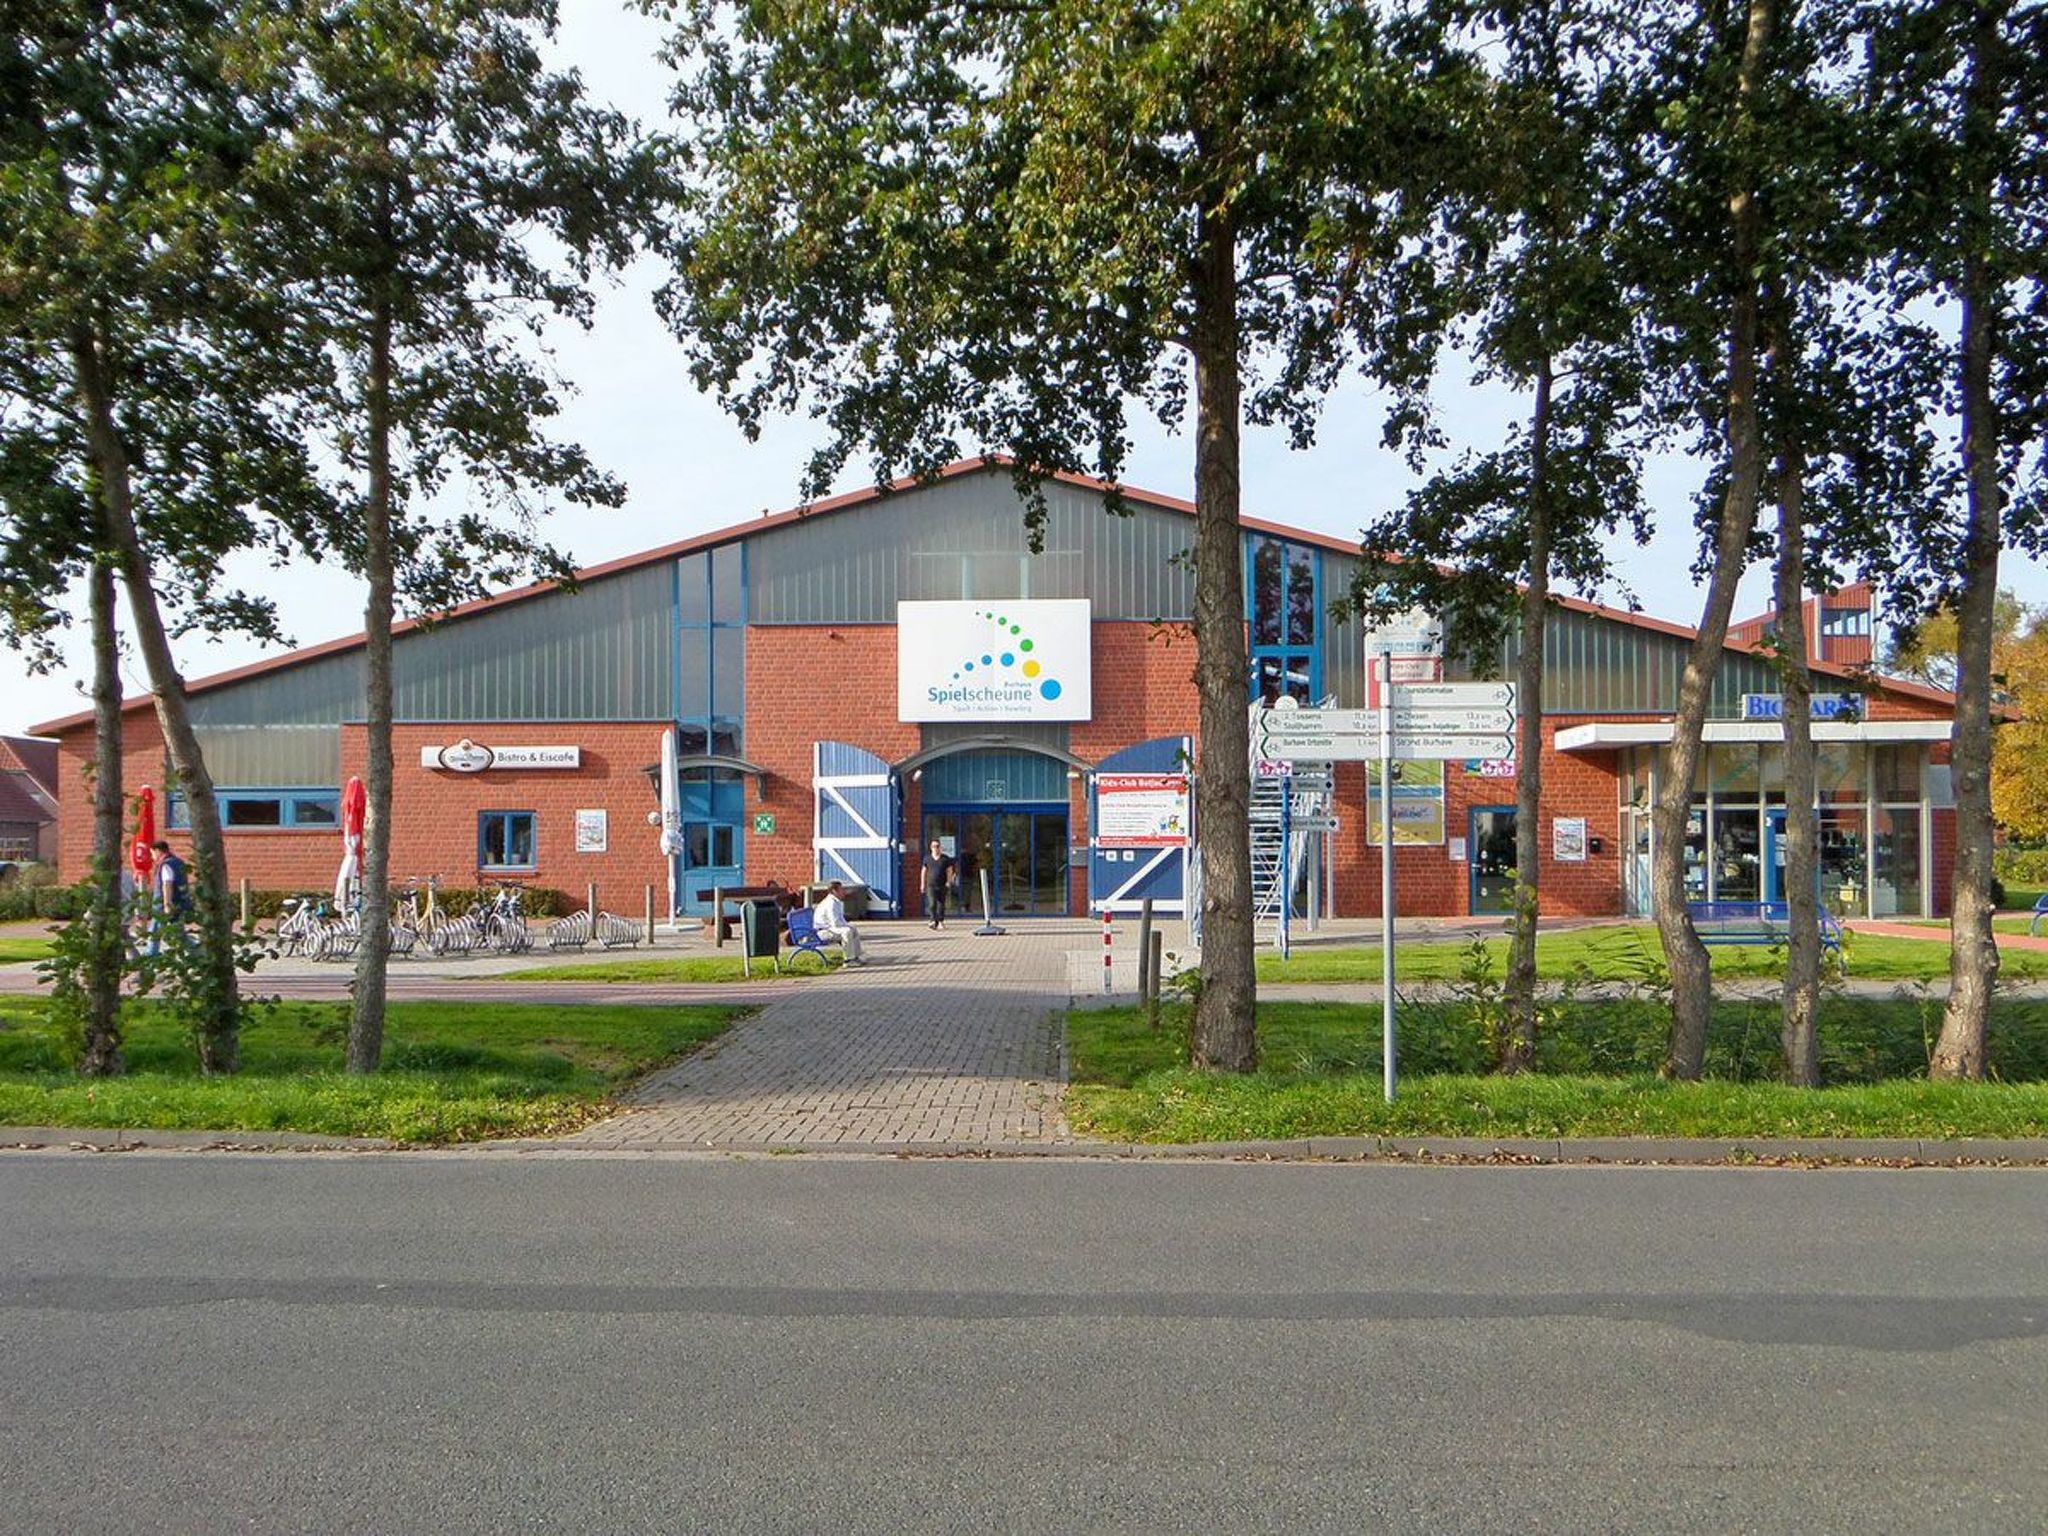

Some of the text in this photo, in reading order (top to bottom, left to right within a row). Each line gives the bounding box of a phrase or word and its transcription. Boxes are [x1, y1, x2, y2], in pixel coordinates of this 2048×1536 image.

[927, 683, 1032, 705] Spielscheune
[497, 751, 526, 762] Bistro
[529, 752, 538, 762] &
